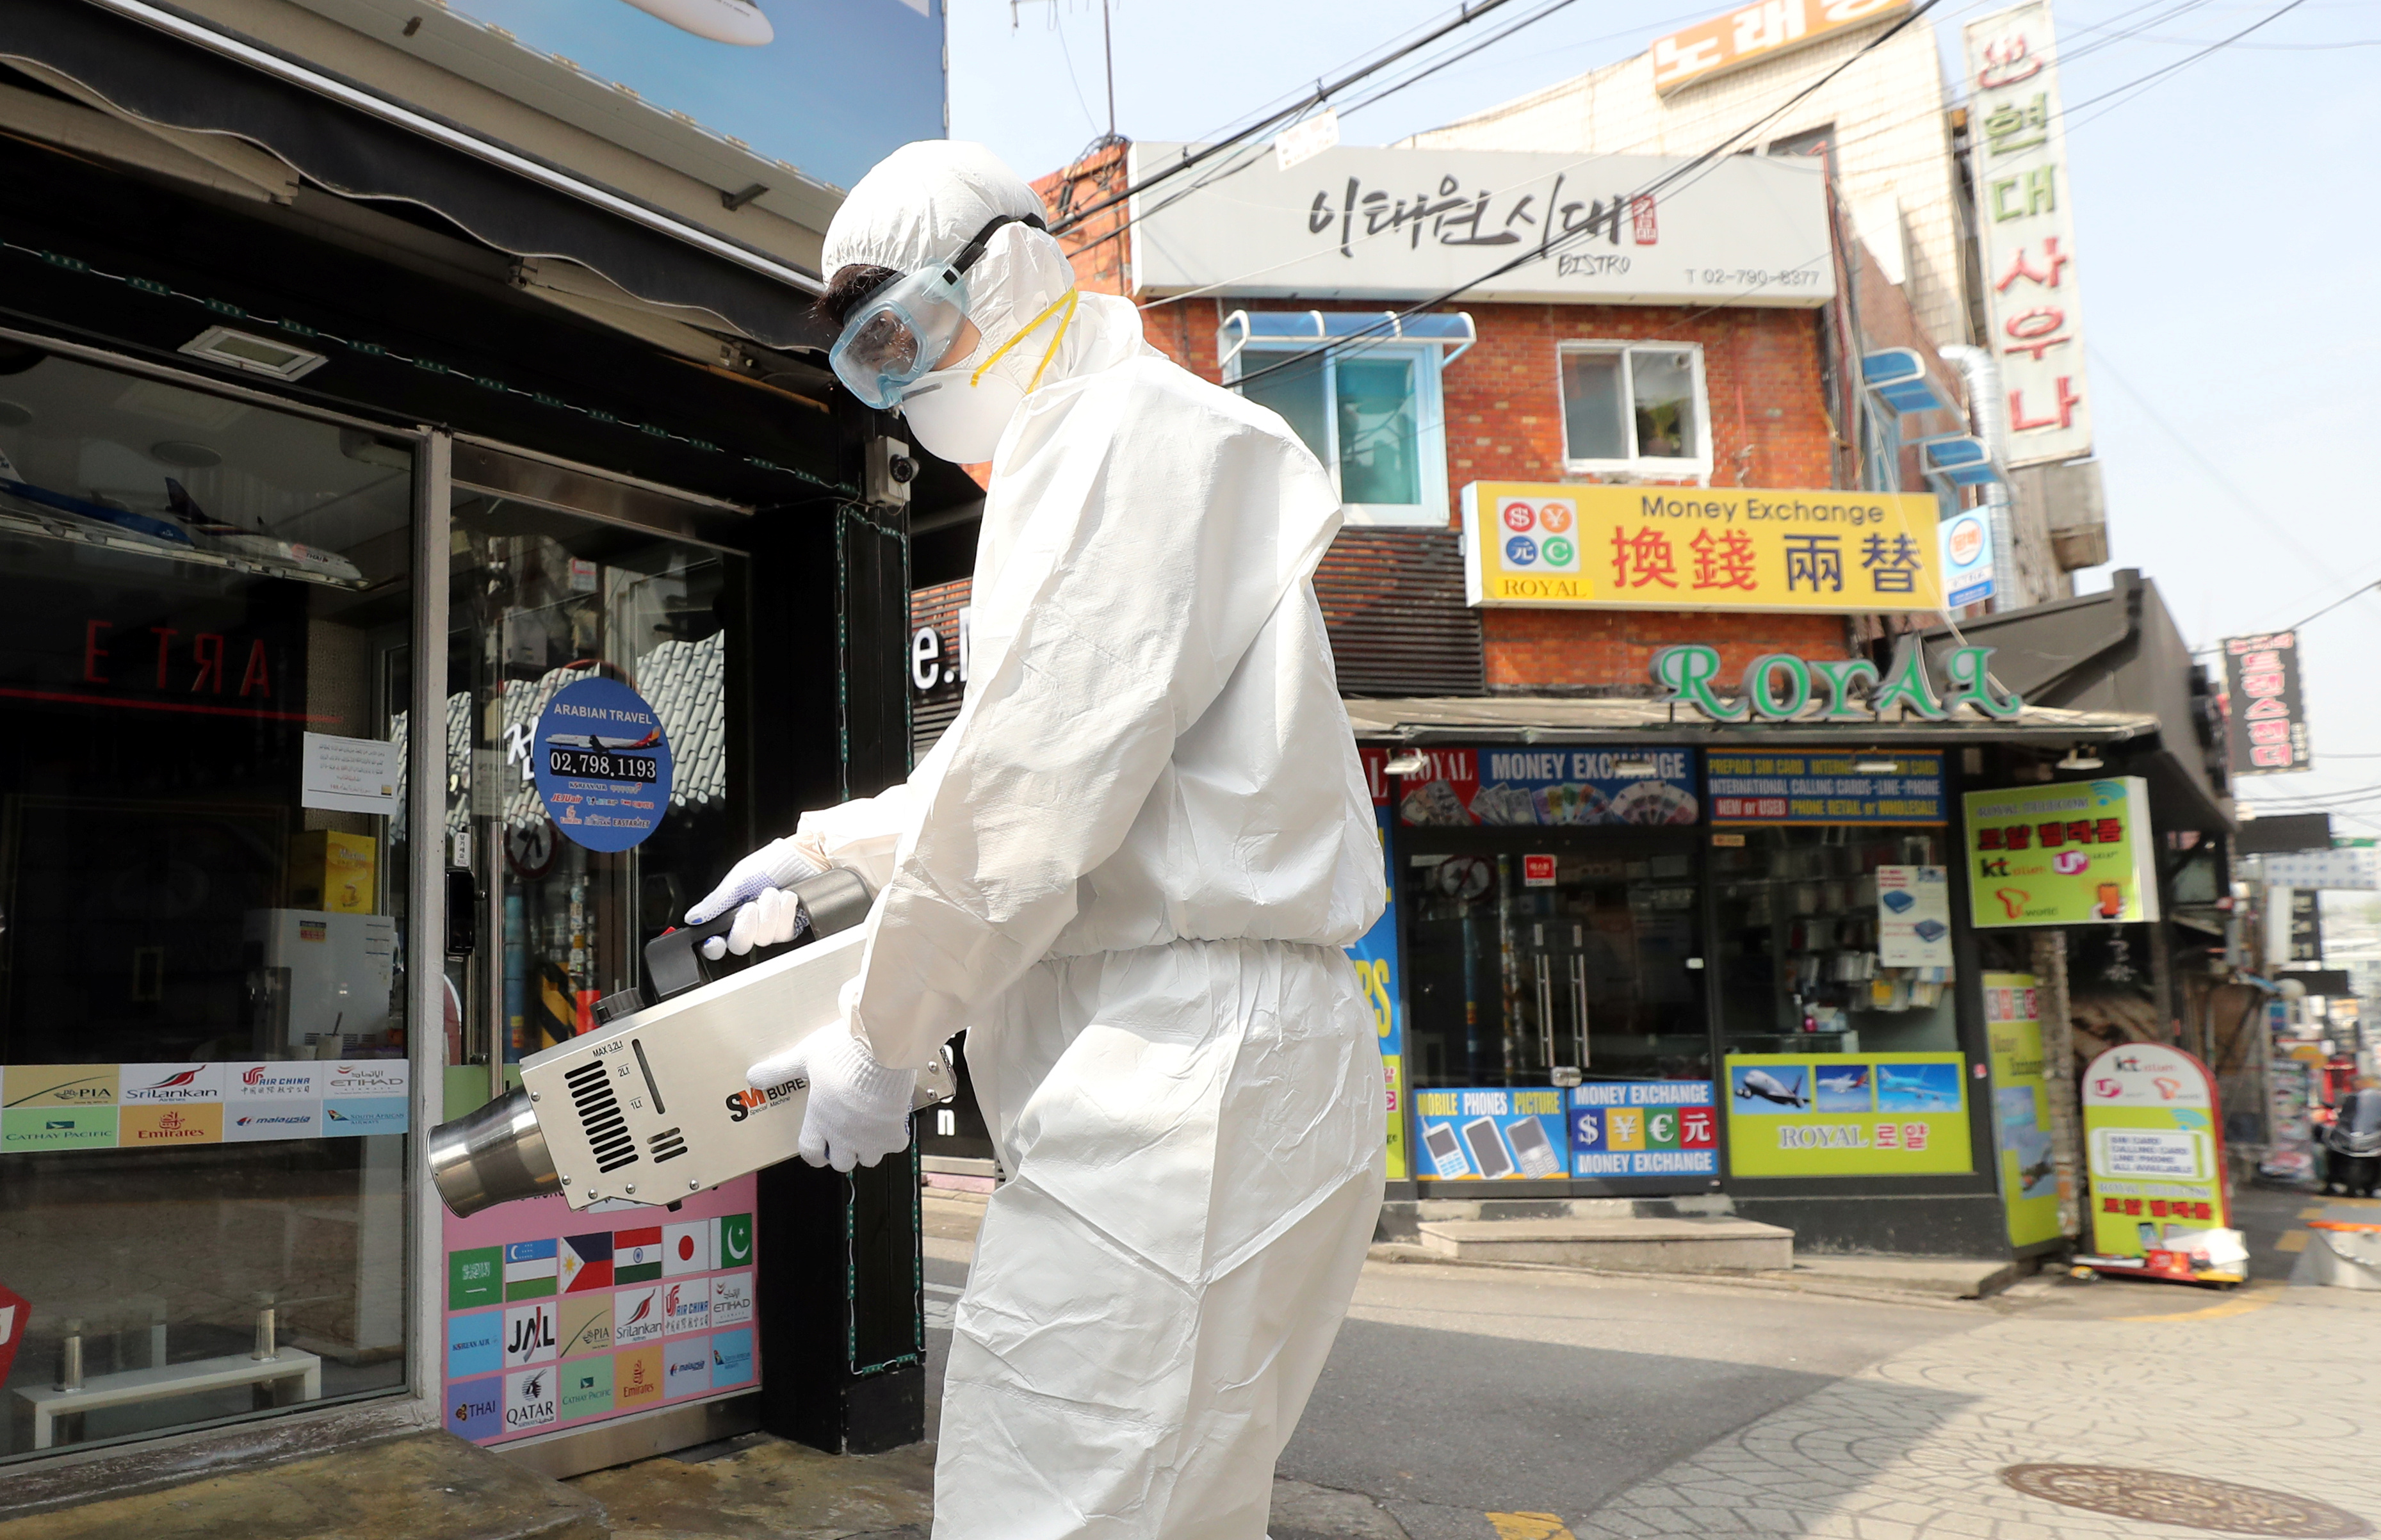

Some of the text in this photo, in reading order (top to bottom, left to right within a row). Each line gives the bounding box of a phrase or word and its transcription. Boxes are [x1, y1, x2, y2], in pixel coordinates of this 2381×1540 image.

[1558, 254, 1631, 277] BISTRO
[1686, 268, 1820, 286] T 02-790-8377
[1641, 495, 1885, 526] Money Exchange
[1504, 579, 1588, 597] ROYAL
[1650, 631, 2022, 721] ROYAL
[554, 703, 653, 725] ARABIAN TRAVEL
[550, 752, 656, 779] 02.798.1193
[1491, 753, 1566, 781] MONEY
[1709, 779, 1789, 795] INTERNATIONAL
[1791, 779, 1834, 795] CALLING
[1759, 798, 1786, 816] USED
[592, 1046, 608, 1058] MAX
[279, 1077, 311, 1085] CHINA
[617, 1066, 631, 1078] 2Lt
[330, 1078, 404, 1087] ETIHAD
[79, 1088, 112, 1098] PIA
[126, 1089, 218, 1099] SriLankan
[1575, 1084, 1709, 1105] MONEY EXCHANGE
[726, 1087, 767, 1123] SM
[749, 1095, 792, 1116] Special Machine
[1417, 1092, 1458, 1116] MOBILE
[1463, 1092, 1507, 1115] PHONES
[1514, 1091, 1560, 1115] PICTURE
[256, 1115, 311, 1124] malaysia
[5, 1130, 112, 1141] CATHAY PACIFIC
[138, 1128, 205, 1139] Emirates
[1780, 1123, 1929, 1150] ROYAL 로얄
[1578, 1151, 1713, 1174] MONEY EXCHANGE
[676, 1300, 709, 1317] AIR CHINA
[713, 1298, 751, 1313] ETIHAD
[507, 1315, 555, 1354] JAL
[594, 1327, 610, 1340] PIA
[616, 1322, 662, 1340] SriLankan
[562, 1388, 612, 1406] CATHAY PACIFIC
[623, 1383, 655, 1398] Emirates
[469, 1400, 496, 1418] THAI
[507, 1400, 554, 1425] QATAR
